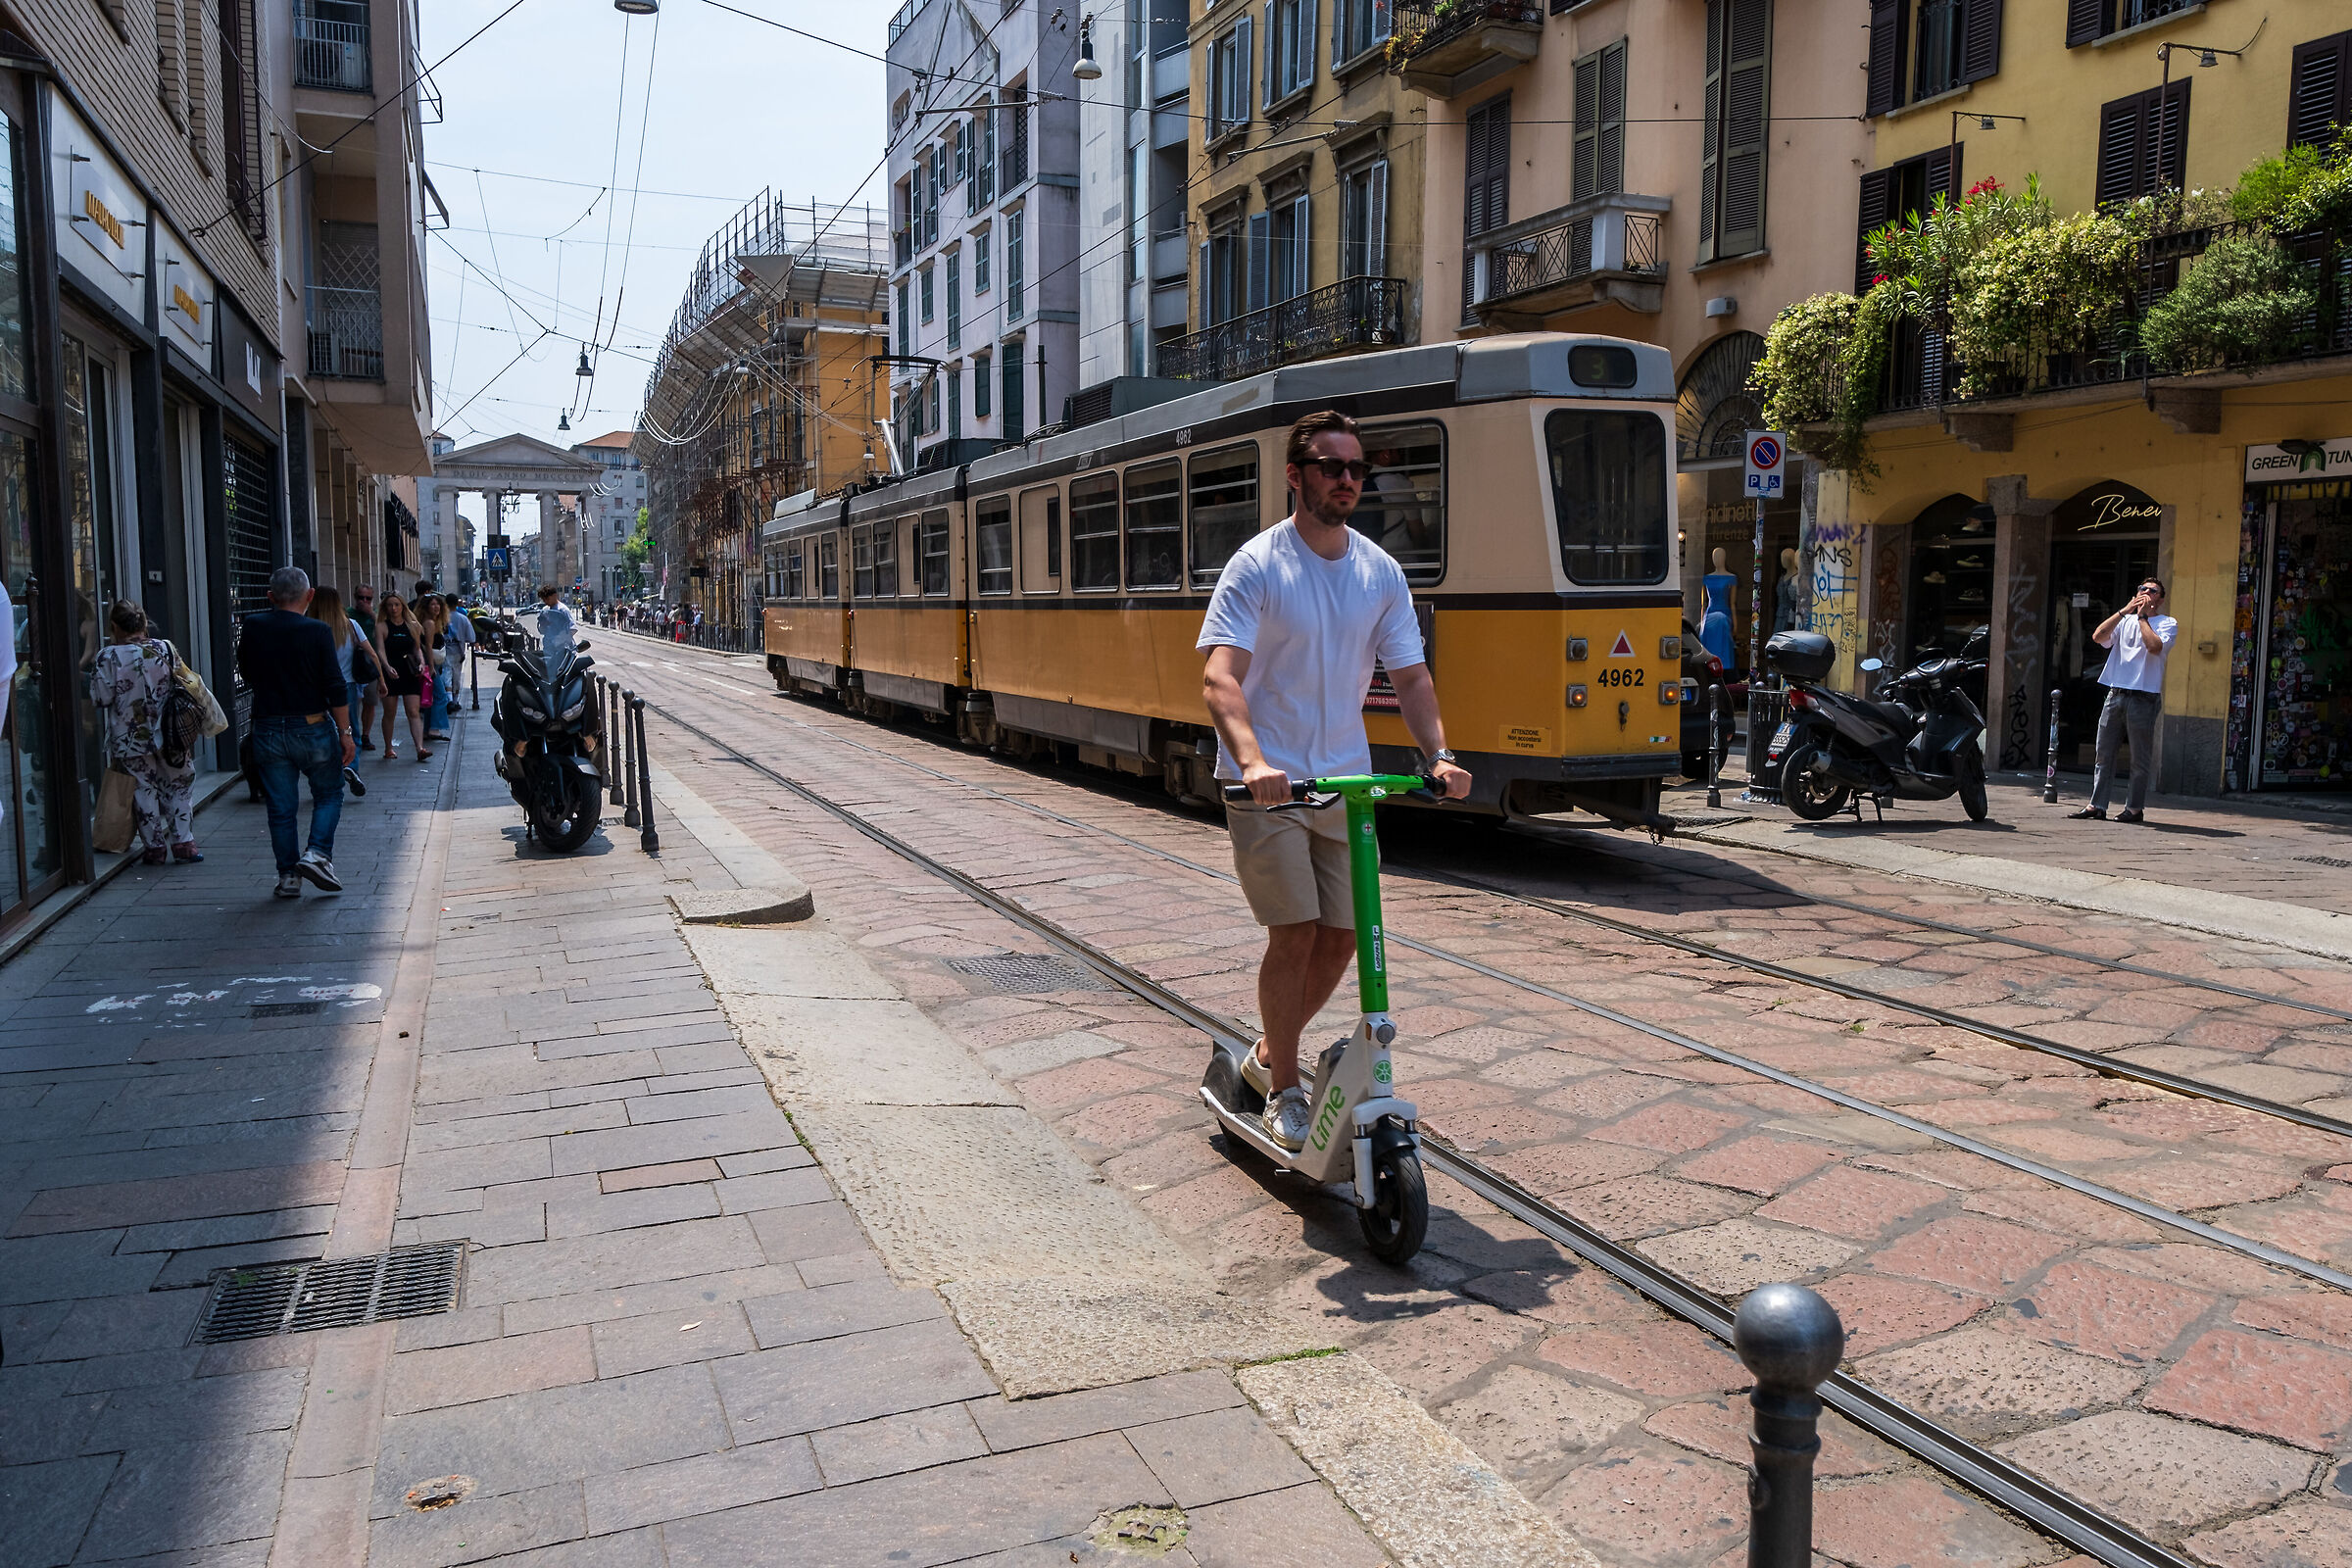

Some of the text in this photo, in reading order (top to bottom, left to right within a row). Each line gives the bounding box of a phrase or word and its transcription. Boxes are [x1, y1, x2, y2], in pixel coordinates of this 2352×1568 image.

[1591, 354, 1604, 379] 3
[1176, 429, 1192, 446] 4962
[2252, 455, 2299, 470] GREEN
[1750, 476, 1758, 486] P
[1597, 668, 1644, 687] 4962
[1310, 1085, 1346, 1152] Lime
